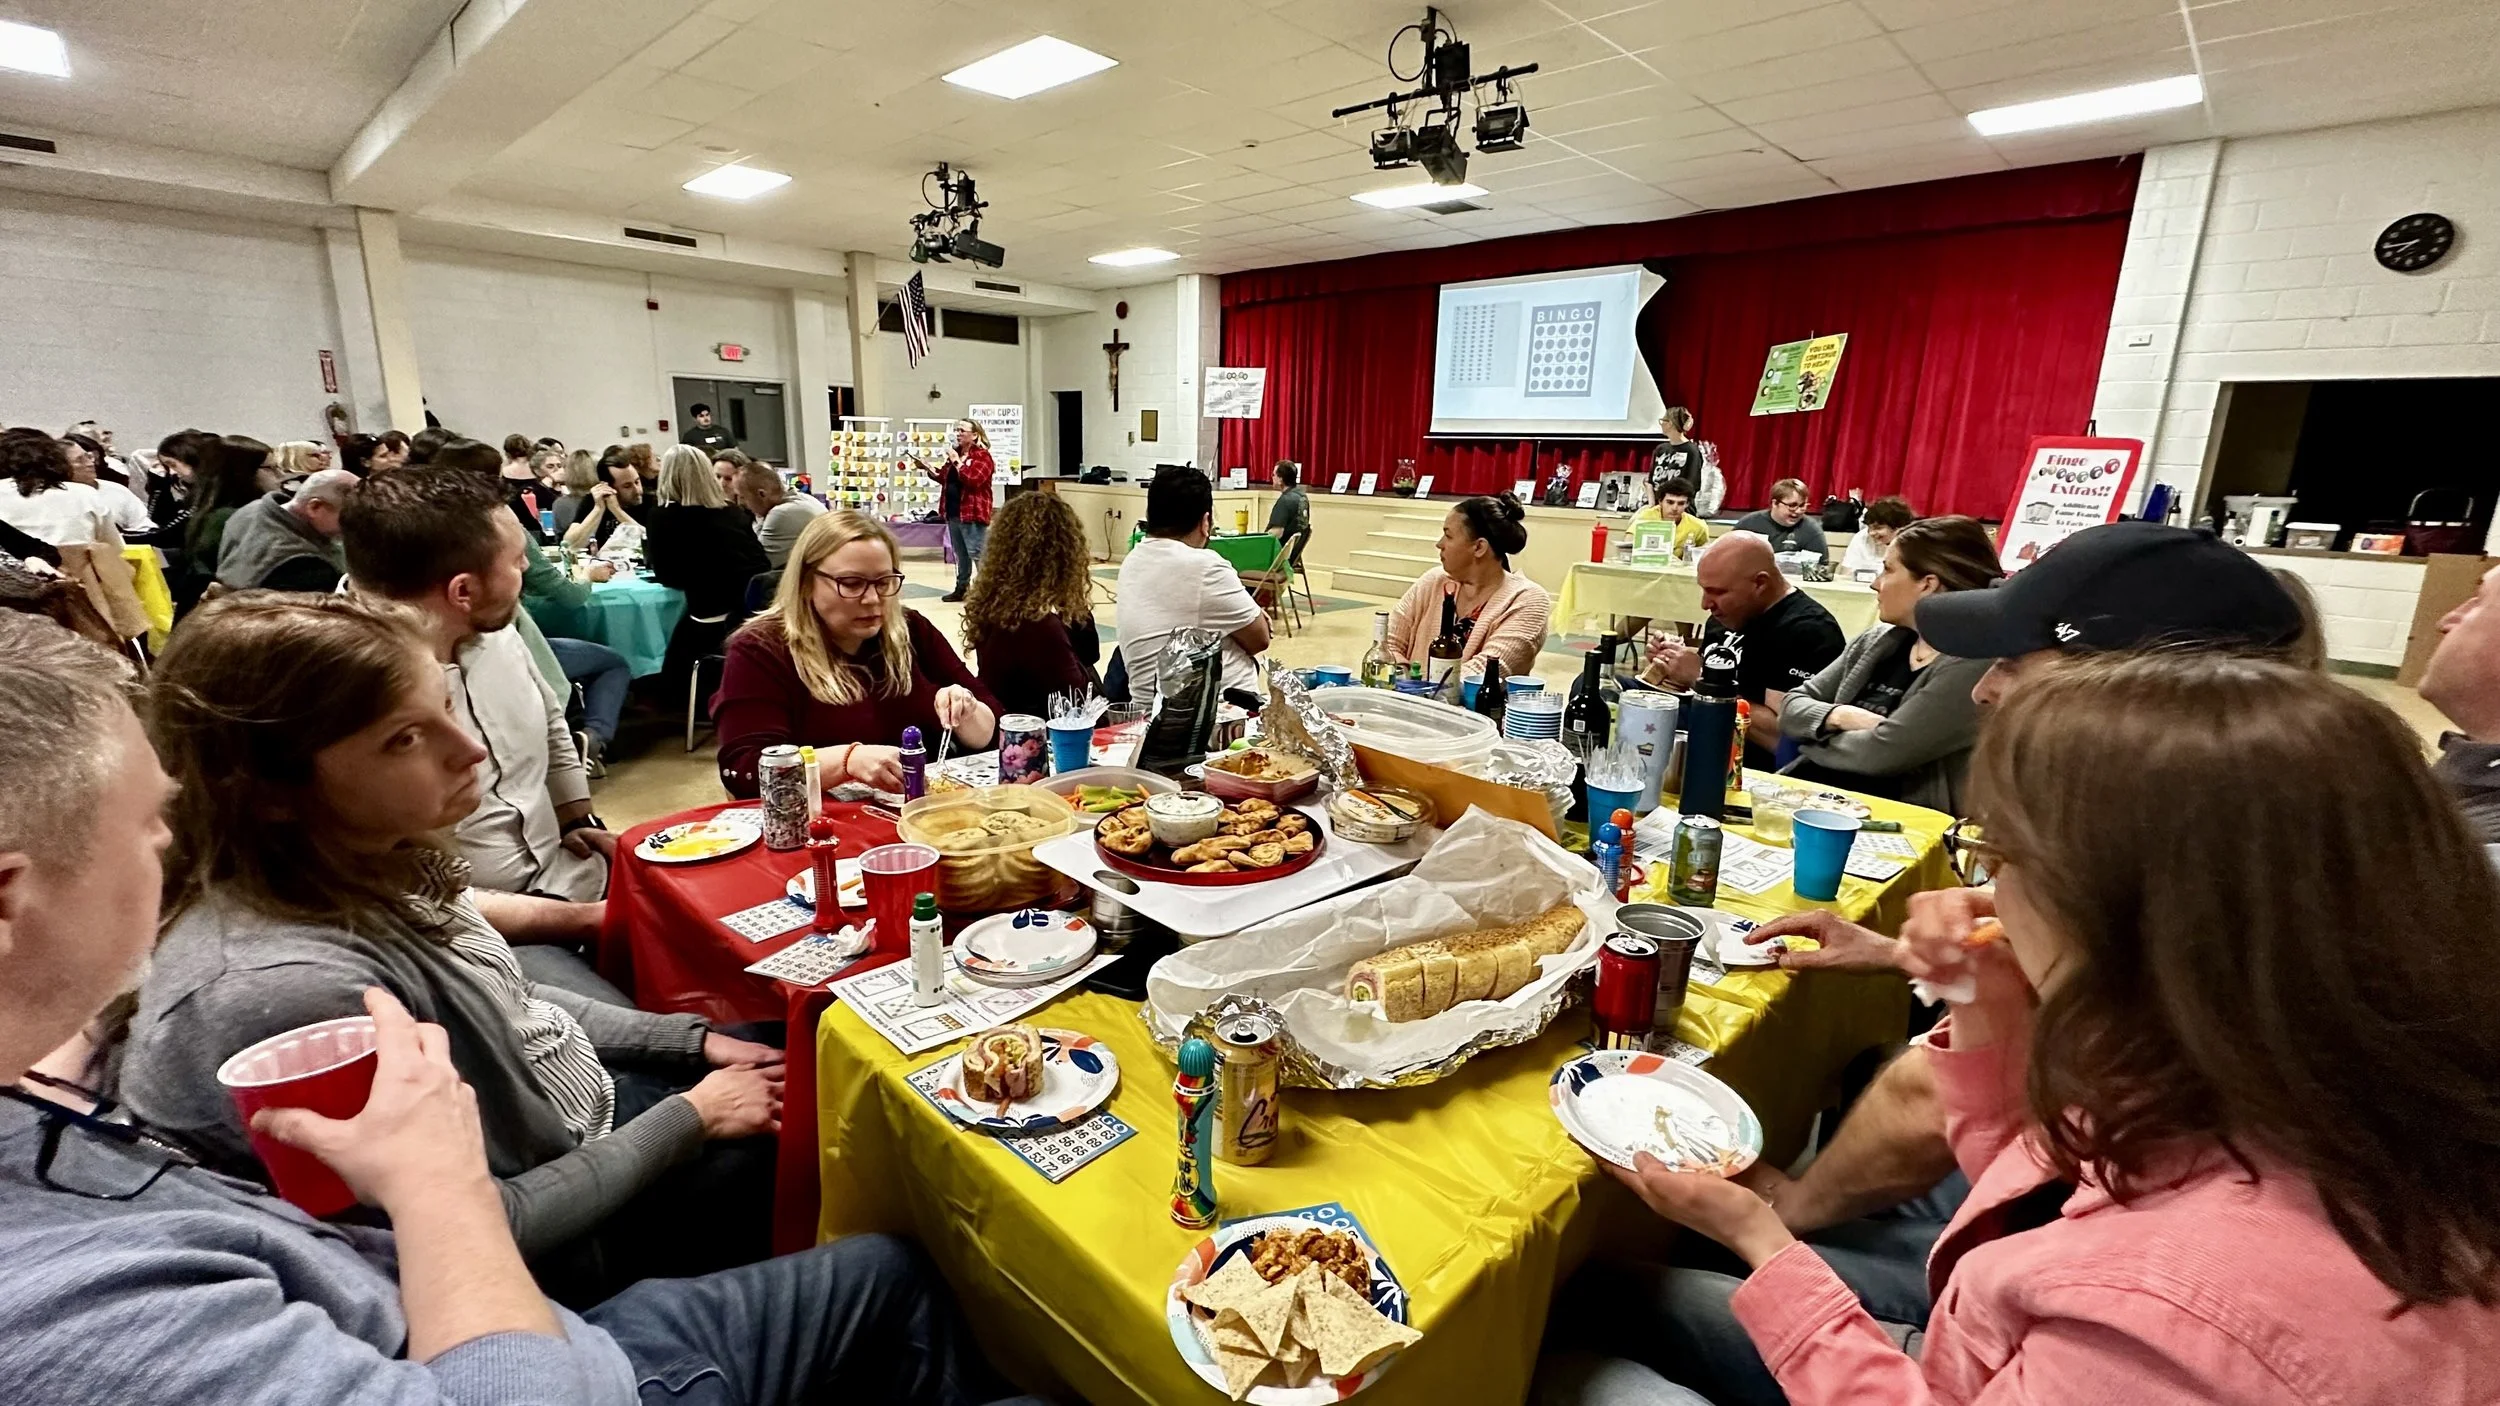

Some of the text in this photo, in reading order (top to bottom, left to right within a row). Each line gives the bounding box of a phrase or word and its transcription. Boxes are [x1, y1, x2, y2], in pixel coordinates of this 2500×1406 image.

[1537, 307, 1595, 322] BINGO
[972, 408, 1019, 416] PUNCH CUPS!
[2047, 454, 2089, 466] Bingo
[1789, 668, 1816, 679] CHICA
[919, 1082, 933, 1092] 29
[1074, 1129, 1087, 1139] 46
[1086, 1138, 1102, 1149] 69
[1087, 1120, 1116, 1141] 59 63
[1007, 1134, 1058, 1173] 22 40 53 72
[1044, 1144, 1060, 1155] 50
[1057, 1153, 1074, 1165] 68
[1059, 1137, 1088, 1157] 56 65
